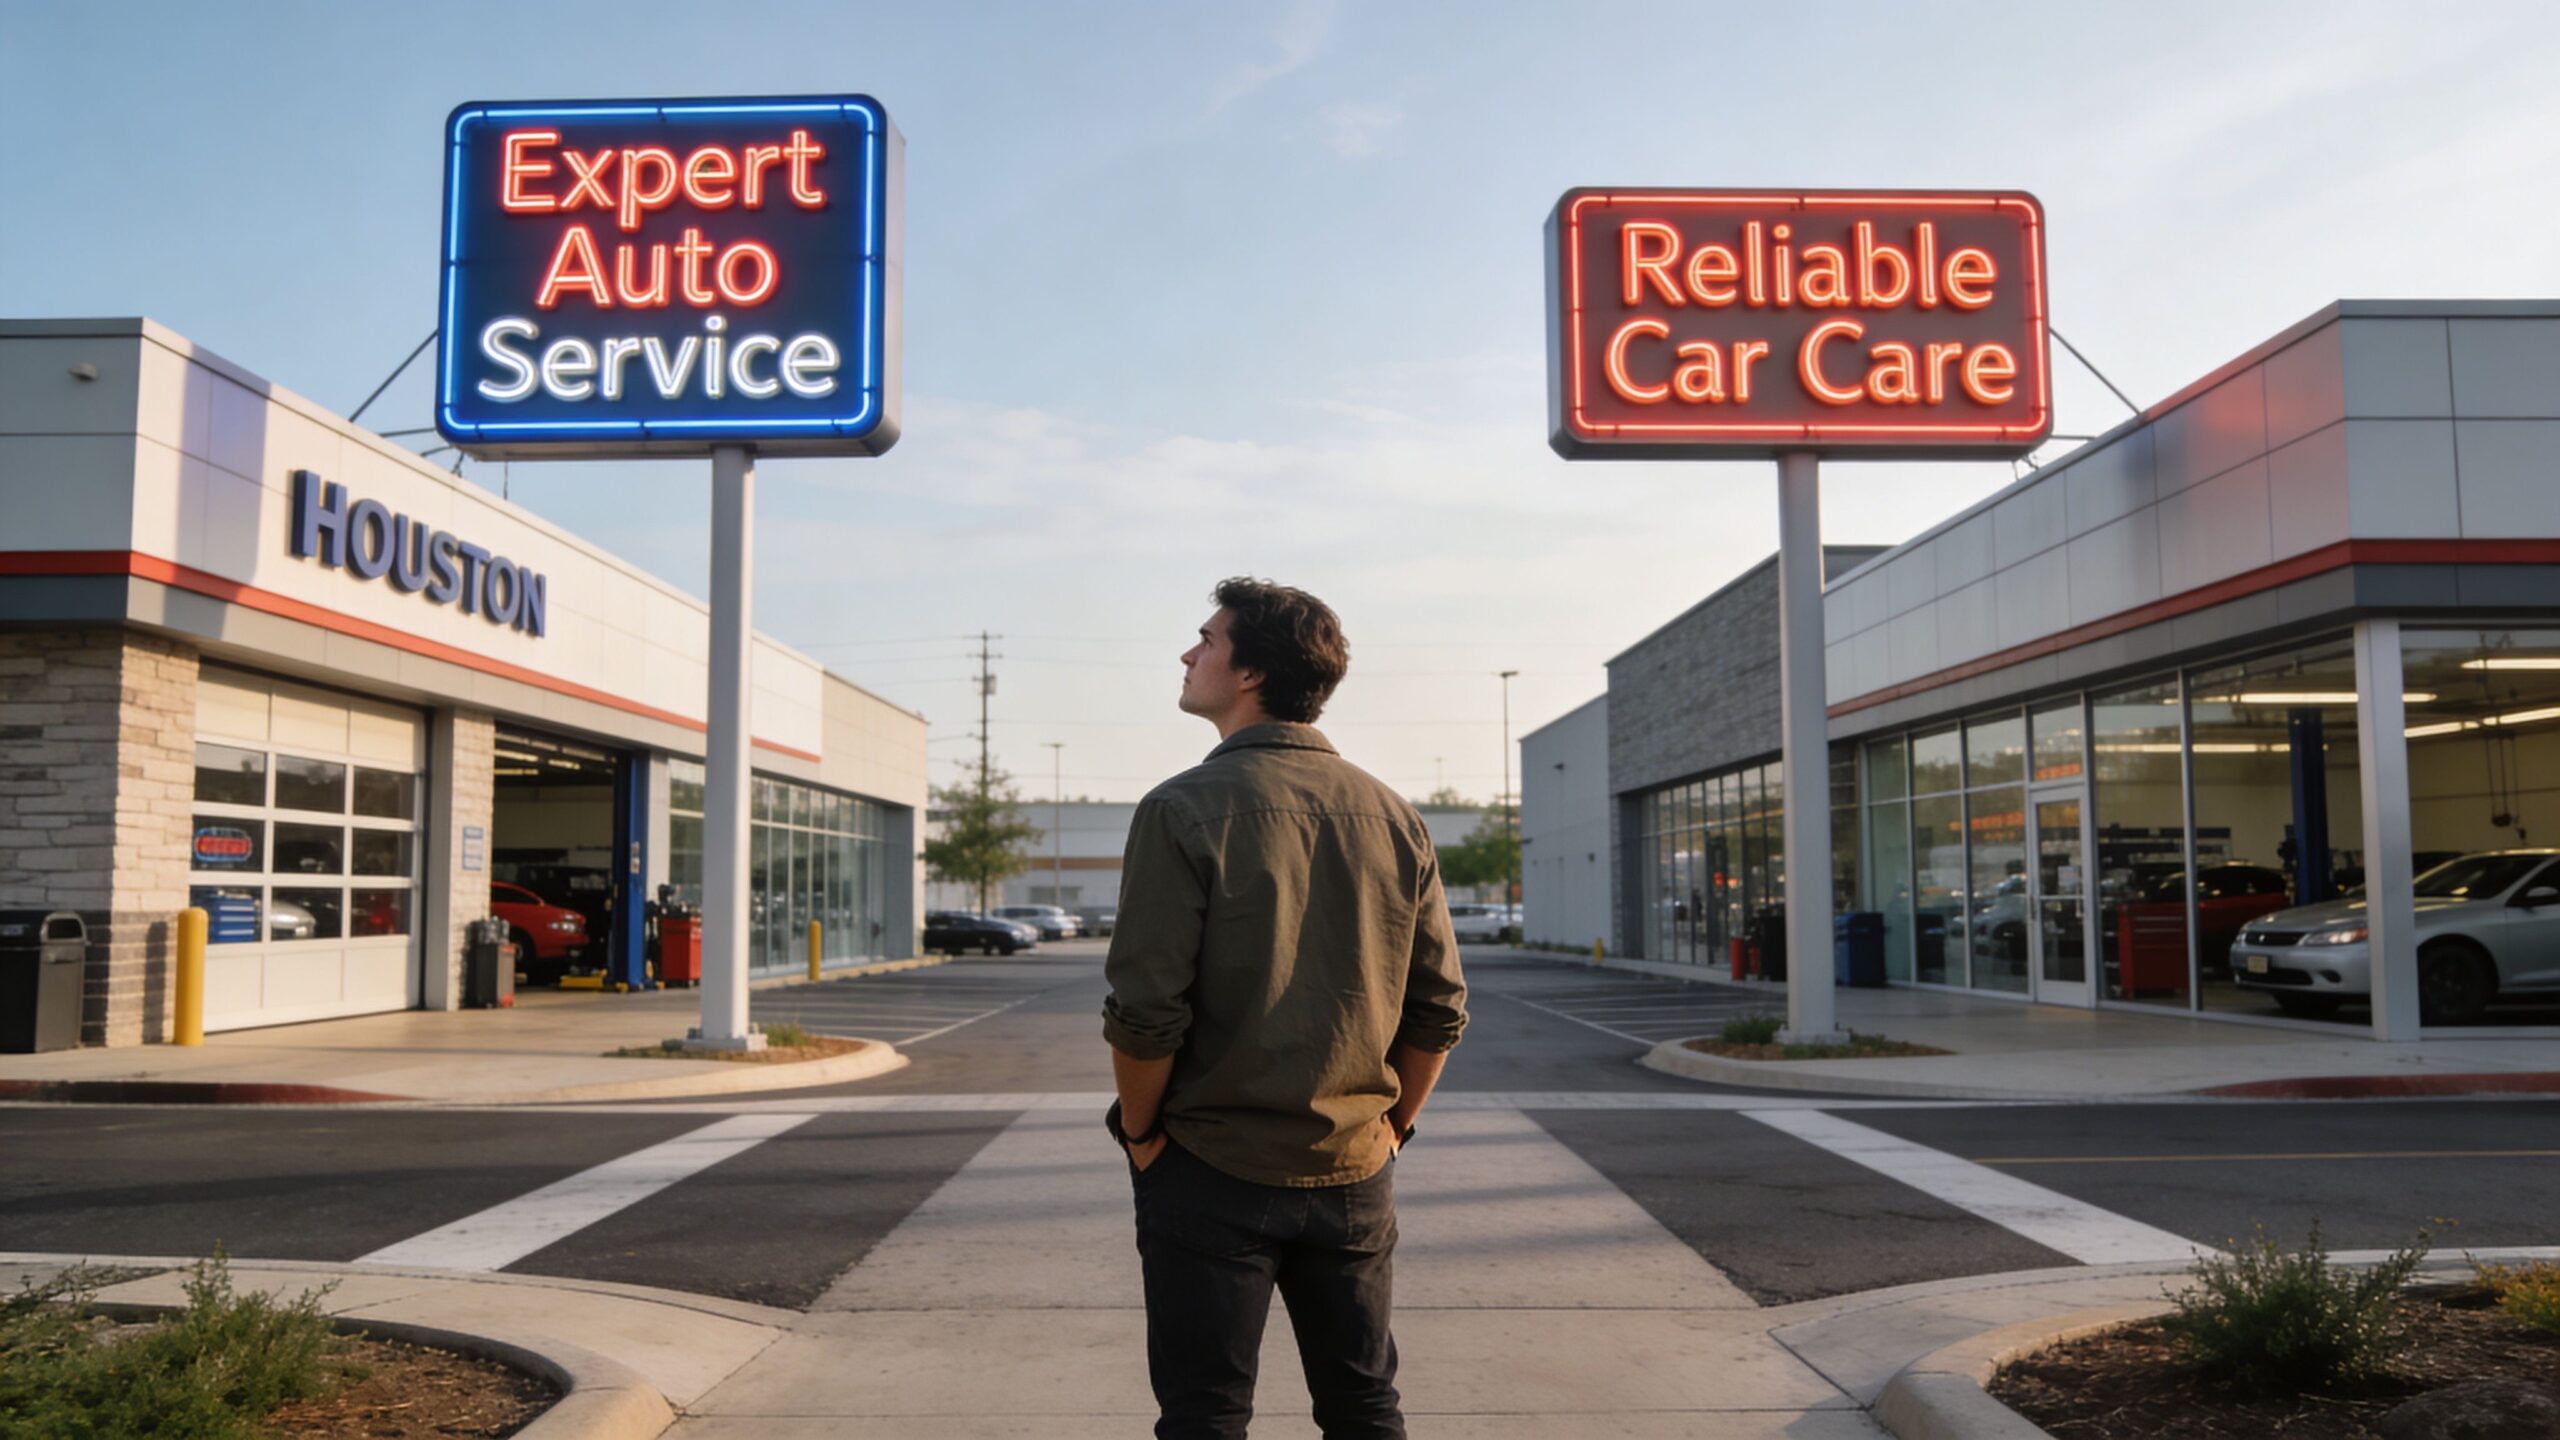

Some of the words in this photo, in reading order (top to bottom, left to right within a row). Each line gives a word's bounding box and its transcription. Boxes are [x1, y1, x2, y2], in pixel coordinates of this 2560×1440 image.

[502, 128, 826, 230] Expert
[537, 226, 778, 308] Auto
[1618, 219, 1998, 308] Reliable
[477, 315, 840, 401] Service
[1604, 318, 1769, 404] Car
[1799, 317, 2017, 405] Care
[291, 469, 547, 638] HOUSTON
